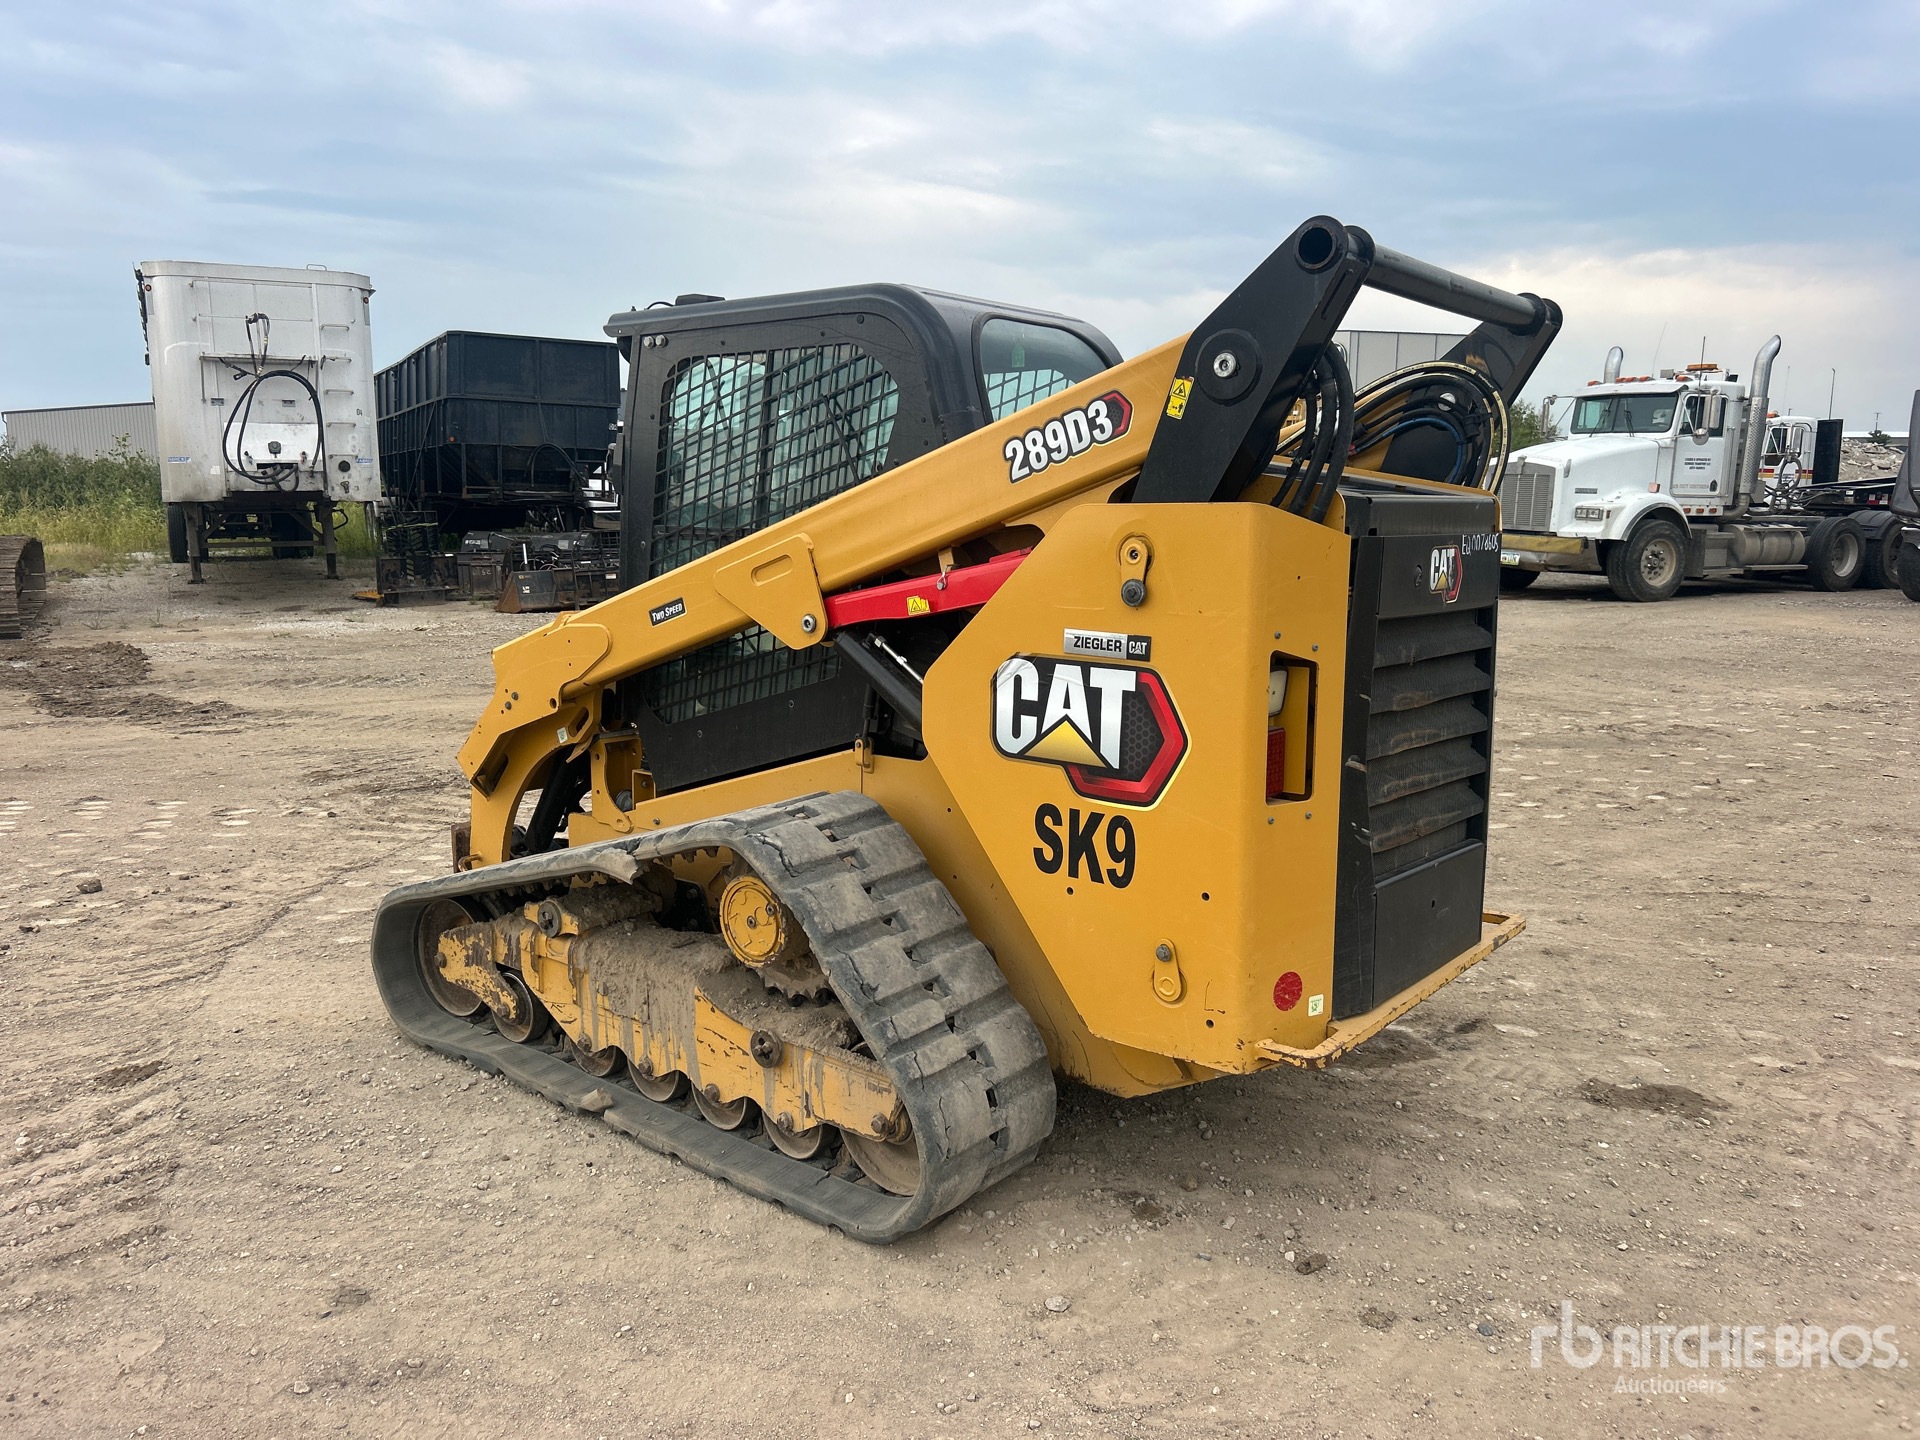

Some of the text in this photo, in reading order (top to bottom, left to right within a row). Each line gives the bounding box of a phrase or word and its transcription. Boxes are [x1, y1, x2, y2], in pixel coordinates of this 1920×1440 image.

[1005, 400, 1113, 480] 289D3
[1430, 549, 1455, 591] CAT
[1073, 635, 1148, 655] ZIEGLER CAT
[996, 657, 1136, 769] CAT
[1033, 803, 1136, 889] SK9
